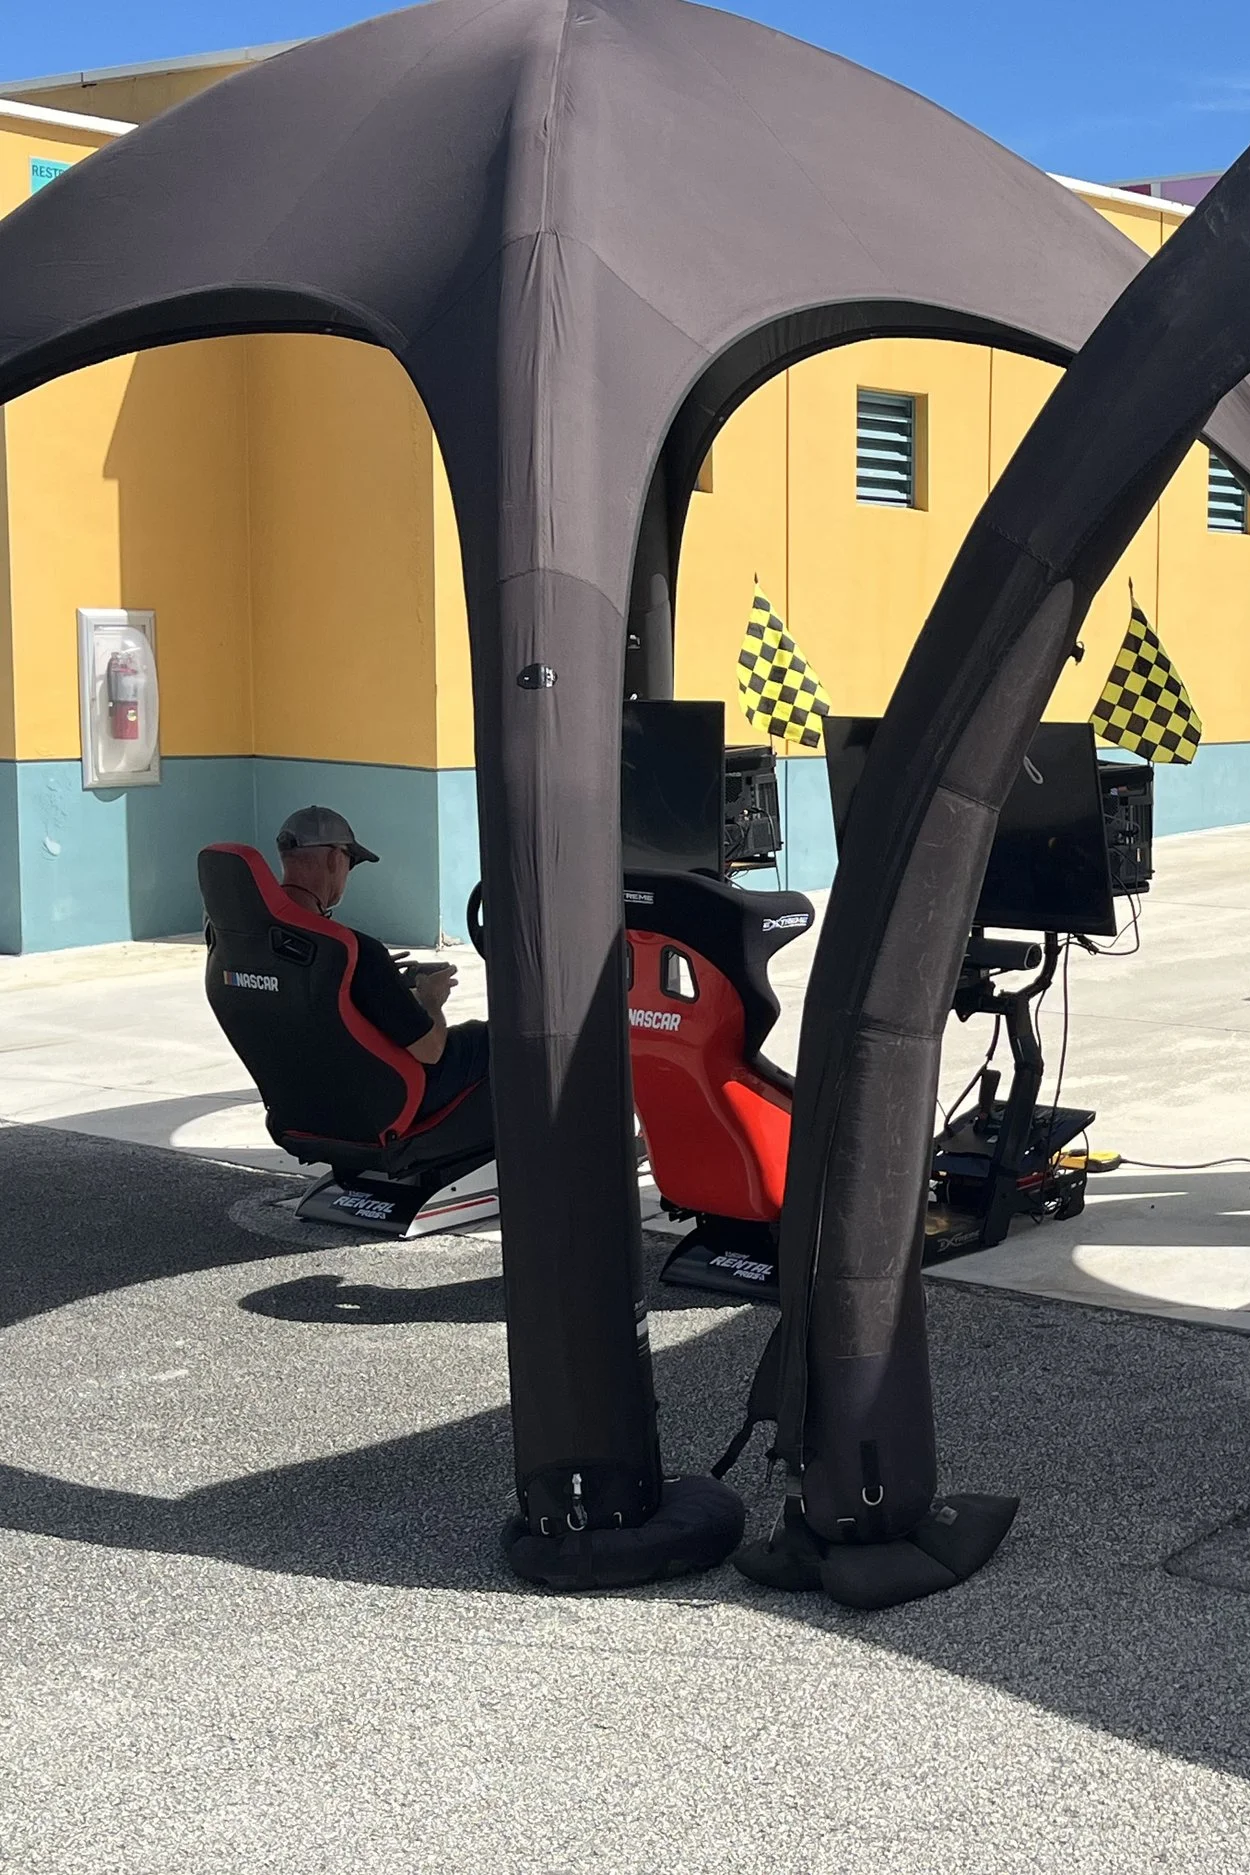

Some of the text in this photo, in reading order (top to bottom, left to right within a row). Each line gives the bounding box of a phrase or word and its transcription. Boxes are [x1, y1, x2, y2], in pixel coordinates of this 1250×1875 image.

[236, 972, 279, 992] NASCAR
[333, 1196, 396, 1213] RENTAL
[709, 1256, 774, 1275] RENTAL
